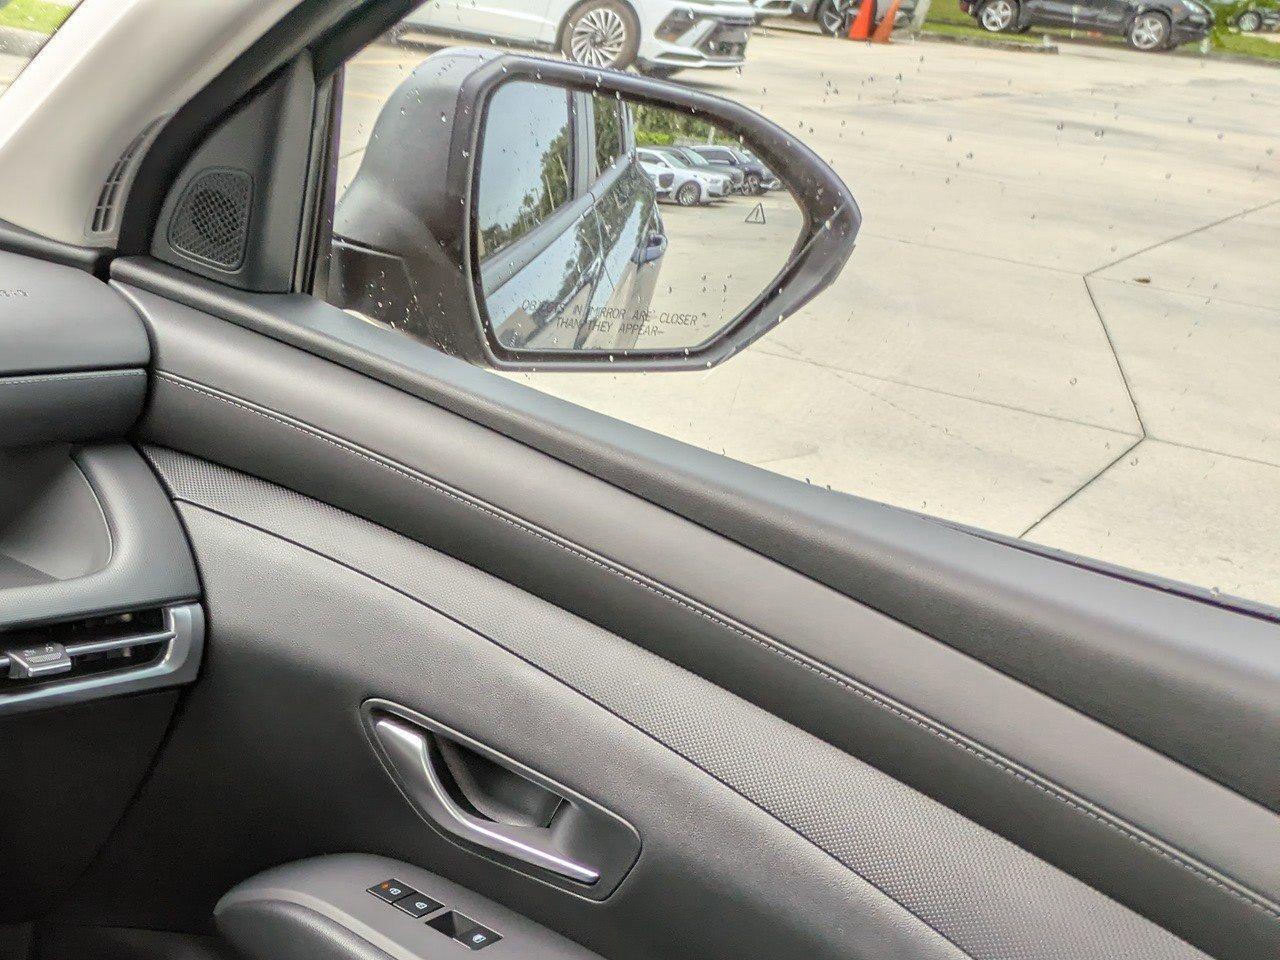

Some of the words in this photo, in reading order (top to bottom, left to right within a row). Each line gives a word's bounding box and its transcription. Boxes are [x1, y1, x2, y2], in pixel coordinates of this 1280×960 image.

[590, 306, 627, 319] MIRROR
[631, 308, 650, 322] ARE
[659, 311, 698, 326] CLOSER
[556, 317, 581, 329] THAN
[588, 319, 614, 333] THEY
[618, 322, 659, 336] APPEAR
